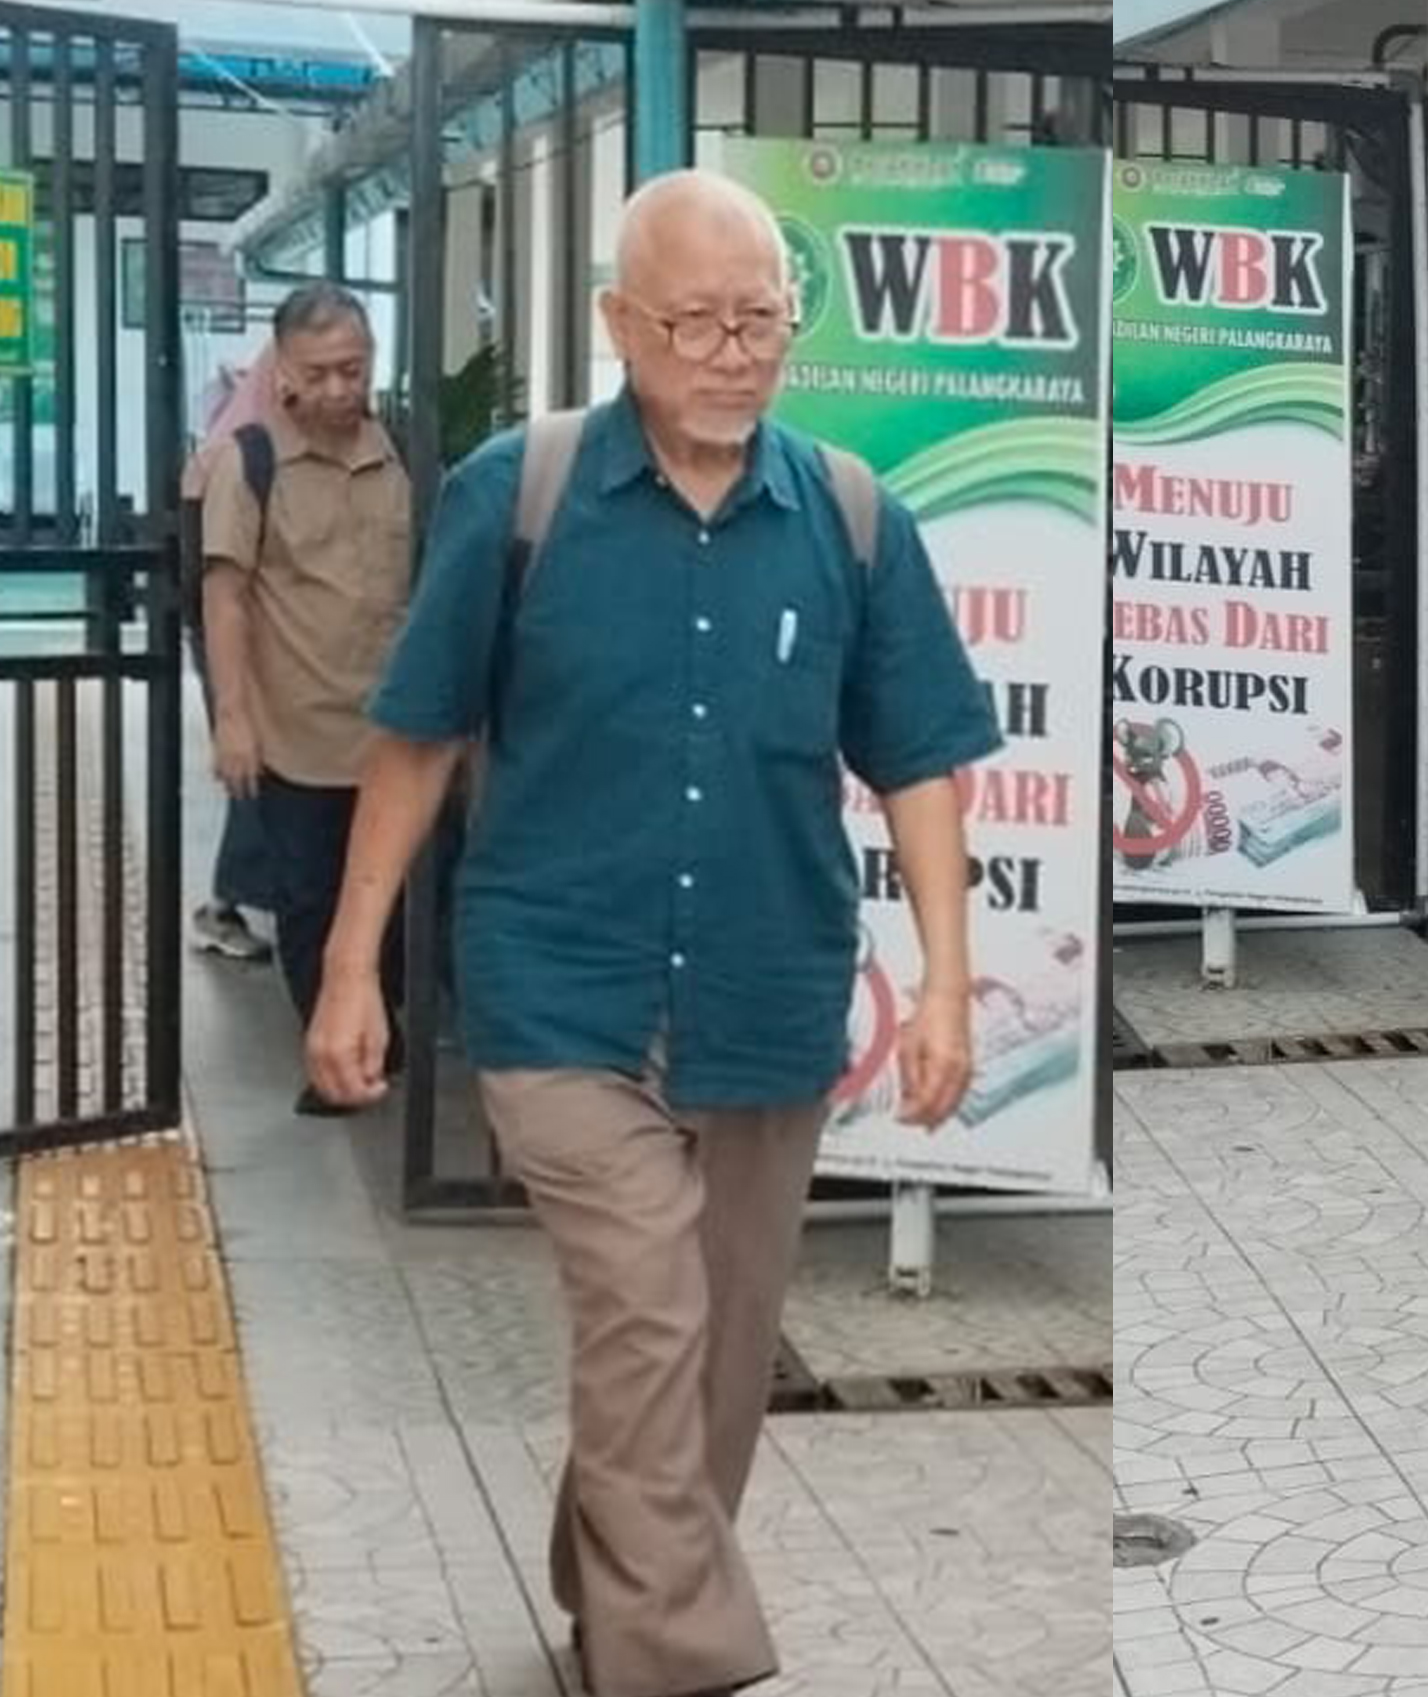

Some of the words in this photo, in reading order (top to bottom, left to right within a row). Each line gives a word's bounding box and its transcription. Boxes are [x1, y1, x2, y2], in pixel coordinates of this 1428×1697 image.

[843, 233, 1072, 340] WBK
[1149, 226, 1322, 309] WBK
[1163, 325, 1217, 346] NEGERI
[1218, 328, 1332, 353] PALANGKARAYA
[1113, 463, 1293, 526] MENUJU
[1113, 601, 1209, 645] EBAS
[1224, 600, 1329, 654] DARI
